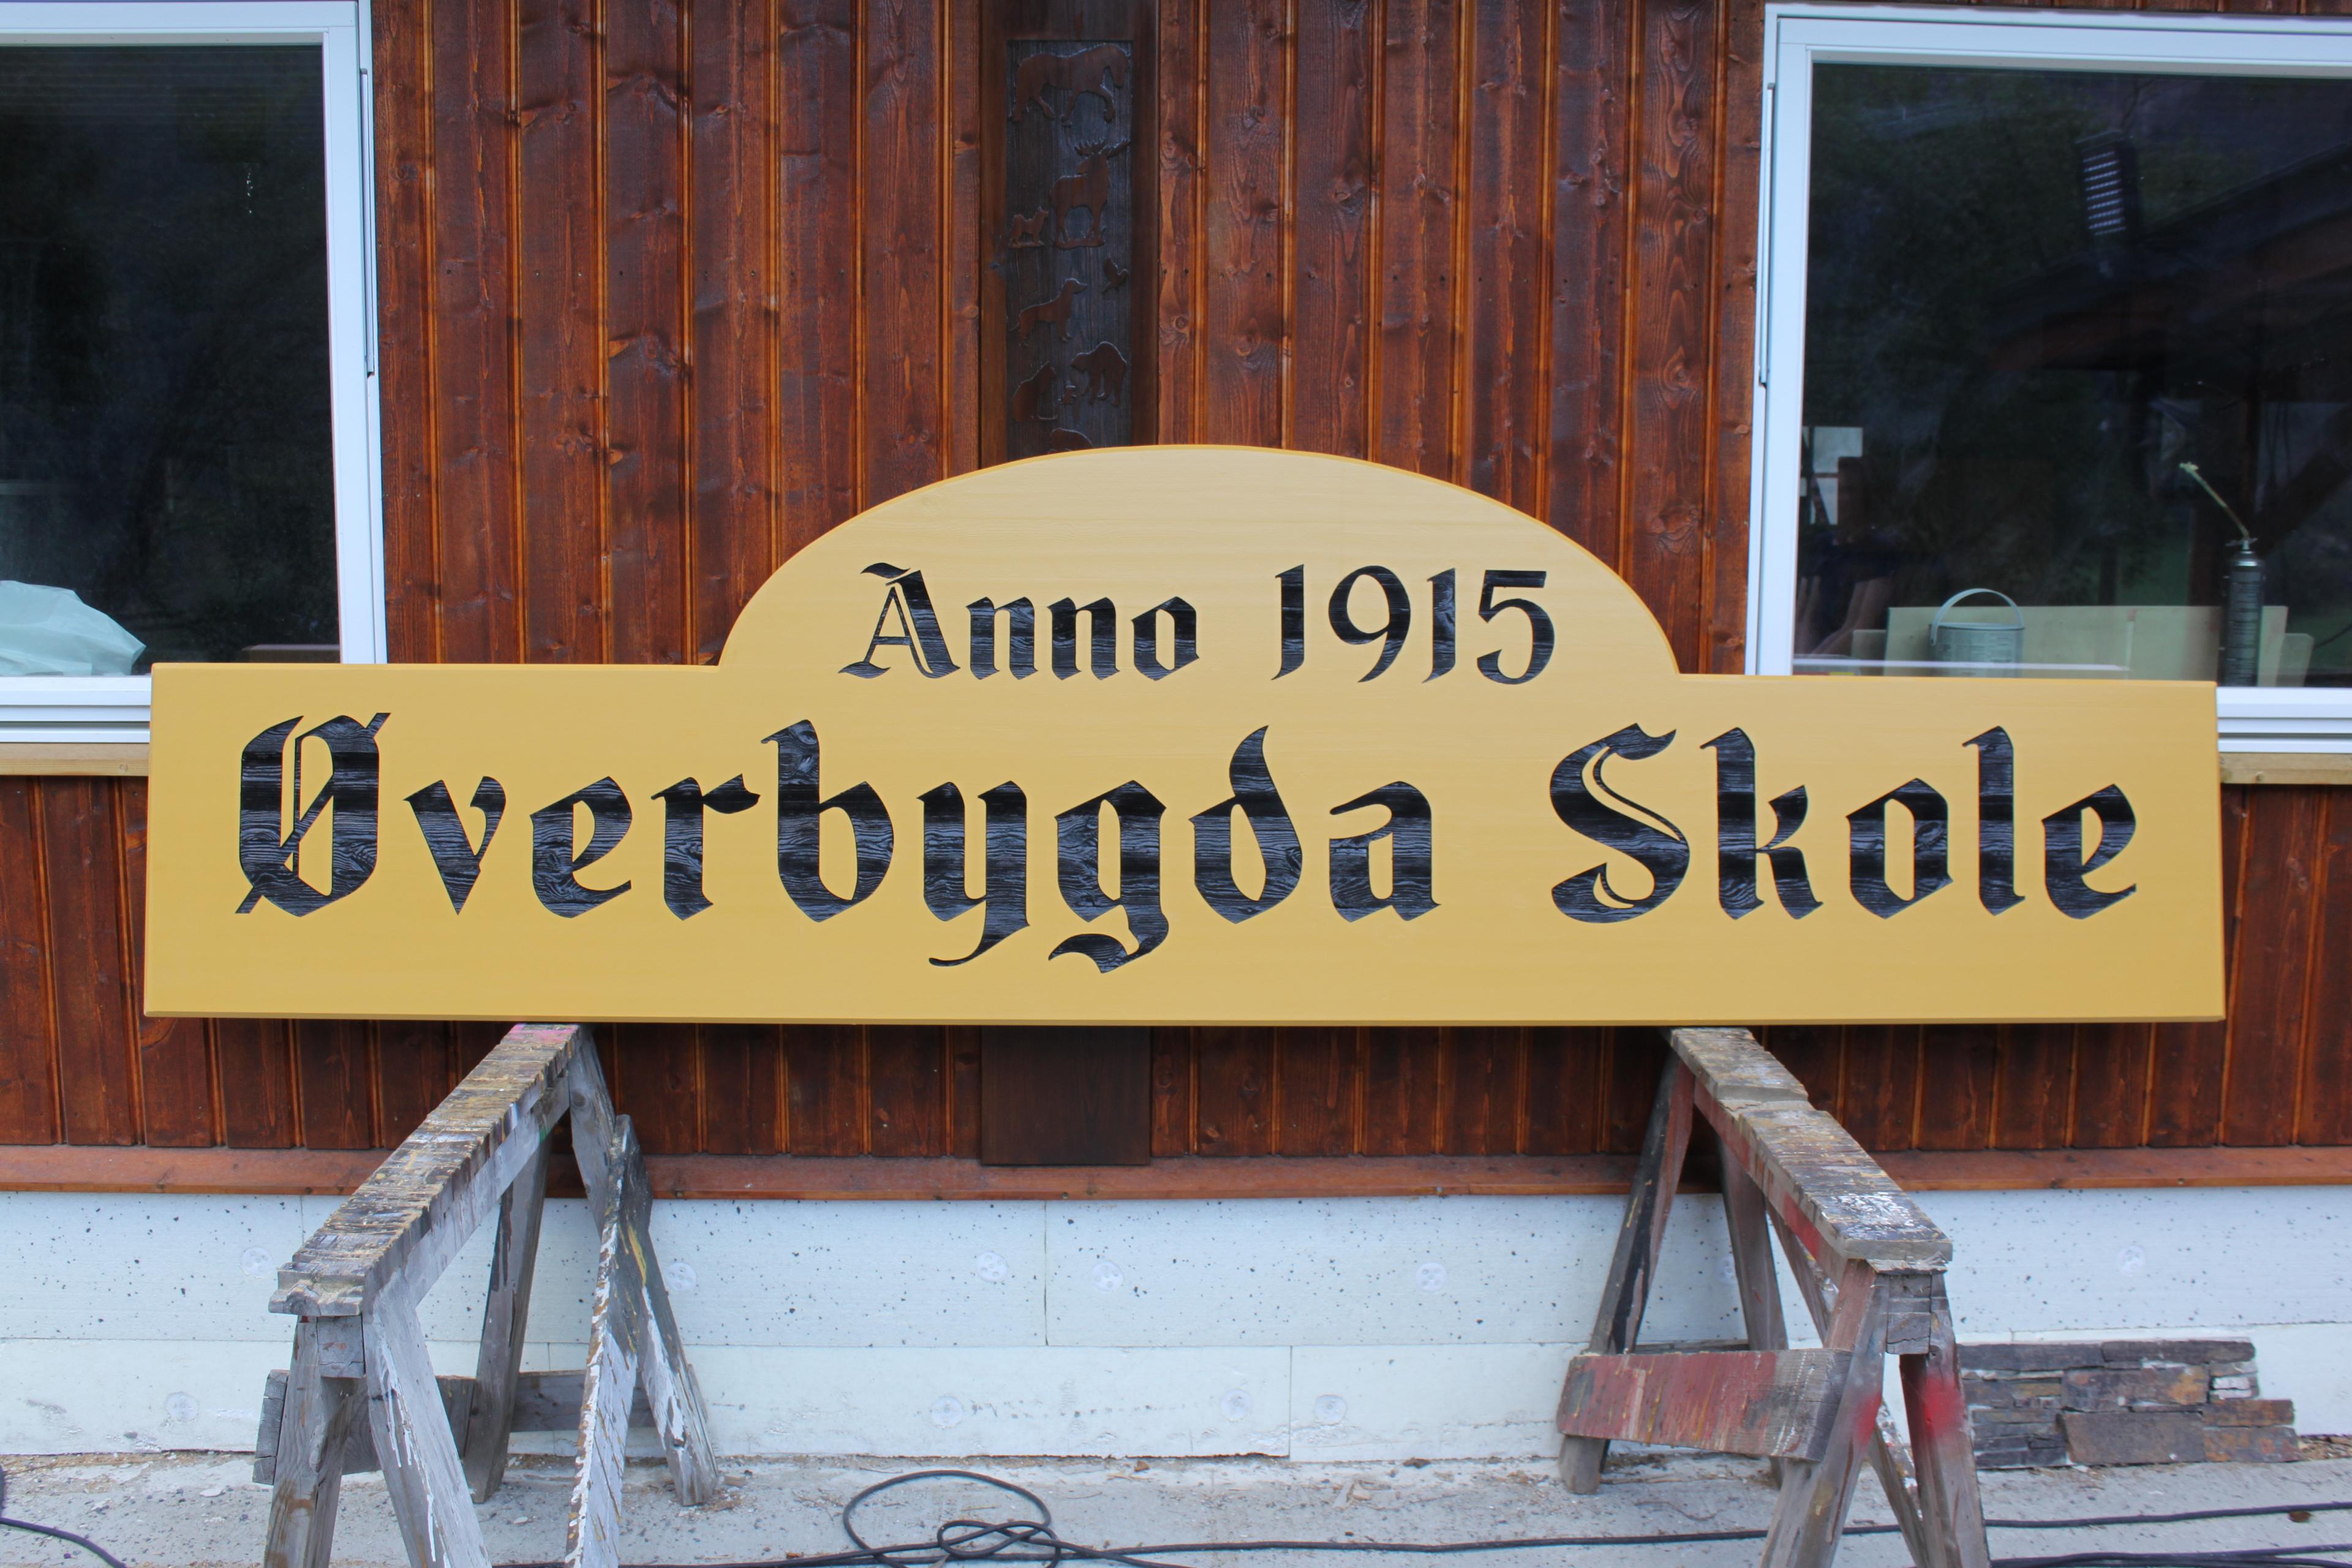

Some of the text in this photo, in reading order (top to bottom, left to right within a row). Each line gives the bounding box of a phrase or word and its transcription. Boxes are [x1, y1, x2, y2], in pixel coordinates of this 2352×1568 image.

[839, 562, 1555, 684] Anno 1915
[236, 712, 2136, 973] Øverbygda Skole
